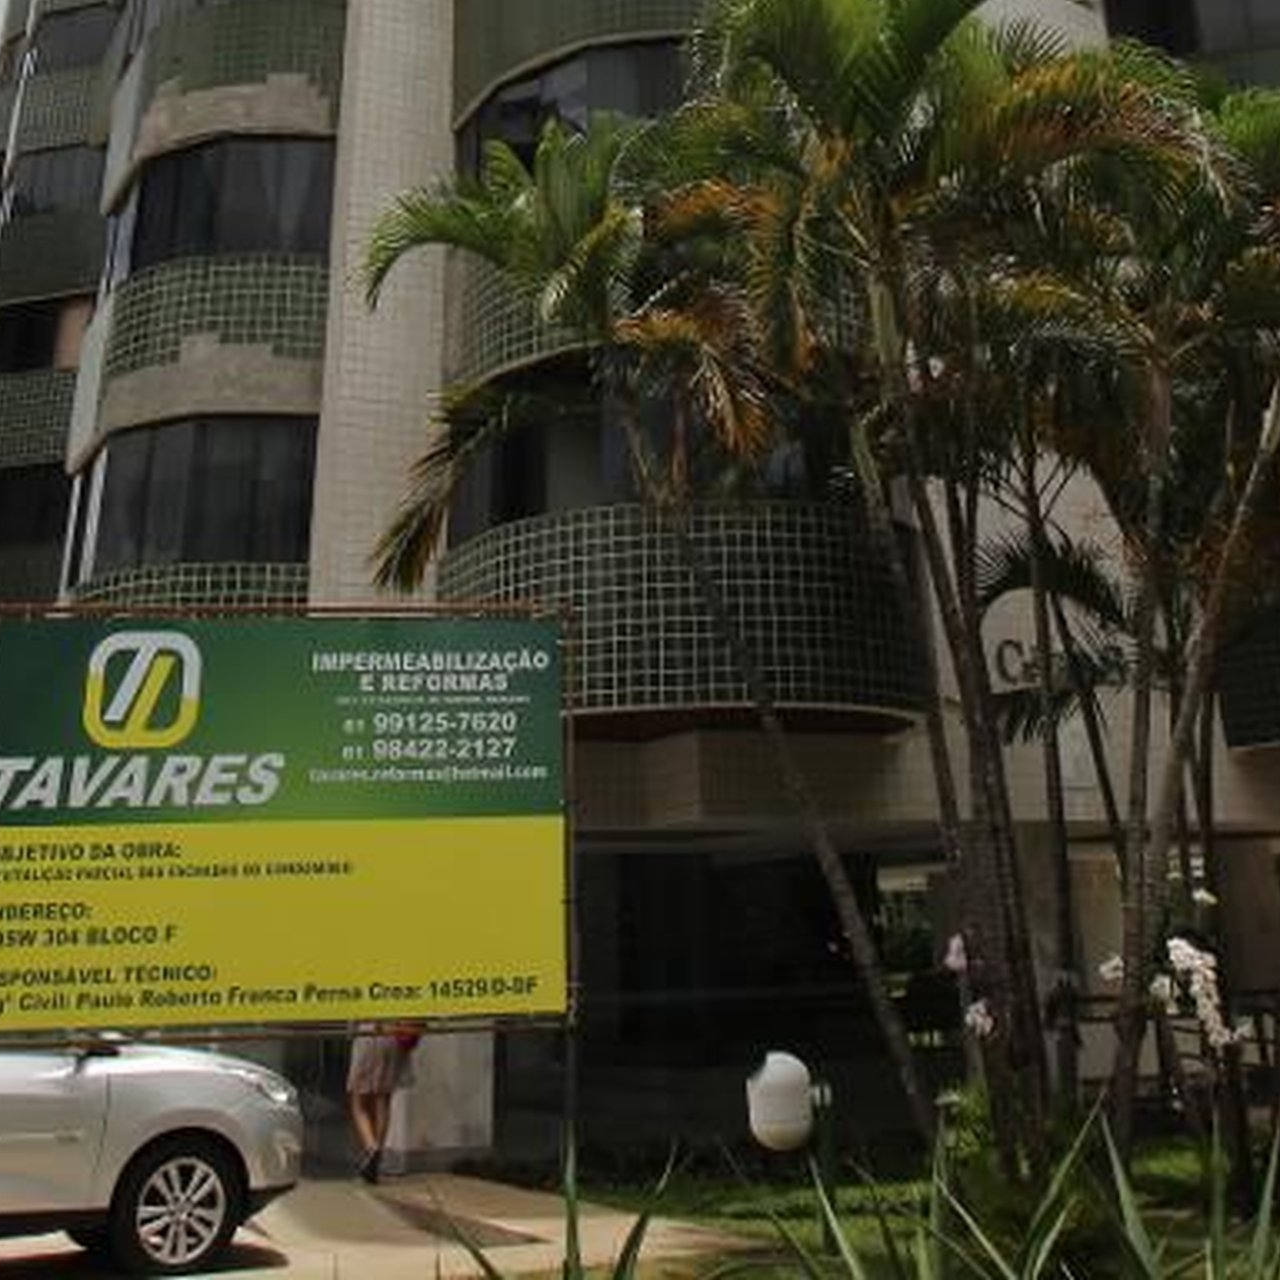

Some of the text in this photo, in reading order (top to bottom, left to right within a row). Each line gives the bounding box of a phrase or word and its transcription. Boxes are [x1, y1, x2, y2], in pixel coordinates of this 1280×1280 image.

[312, 649, 551, 674] IMPERMEABILIZAÇÃO
[360, 673, 508, 692] E REFORMAS
[373, 711, 517, 734] 99125-7620
[373, 737, 517, 760] 98422-2127
[89, 842, 116, 860] DA
[121, 841, 182, 861] OBRA:
[42, 928, 80, 948] 304
[86, 925, 158, 946] BLOCO
[165, 924, 178, 943] F
[139, 988, 221, 1008] Roberto
